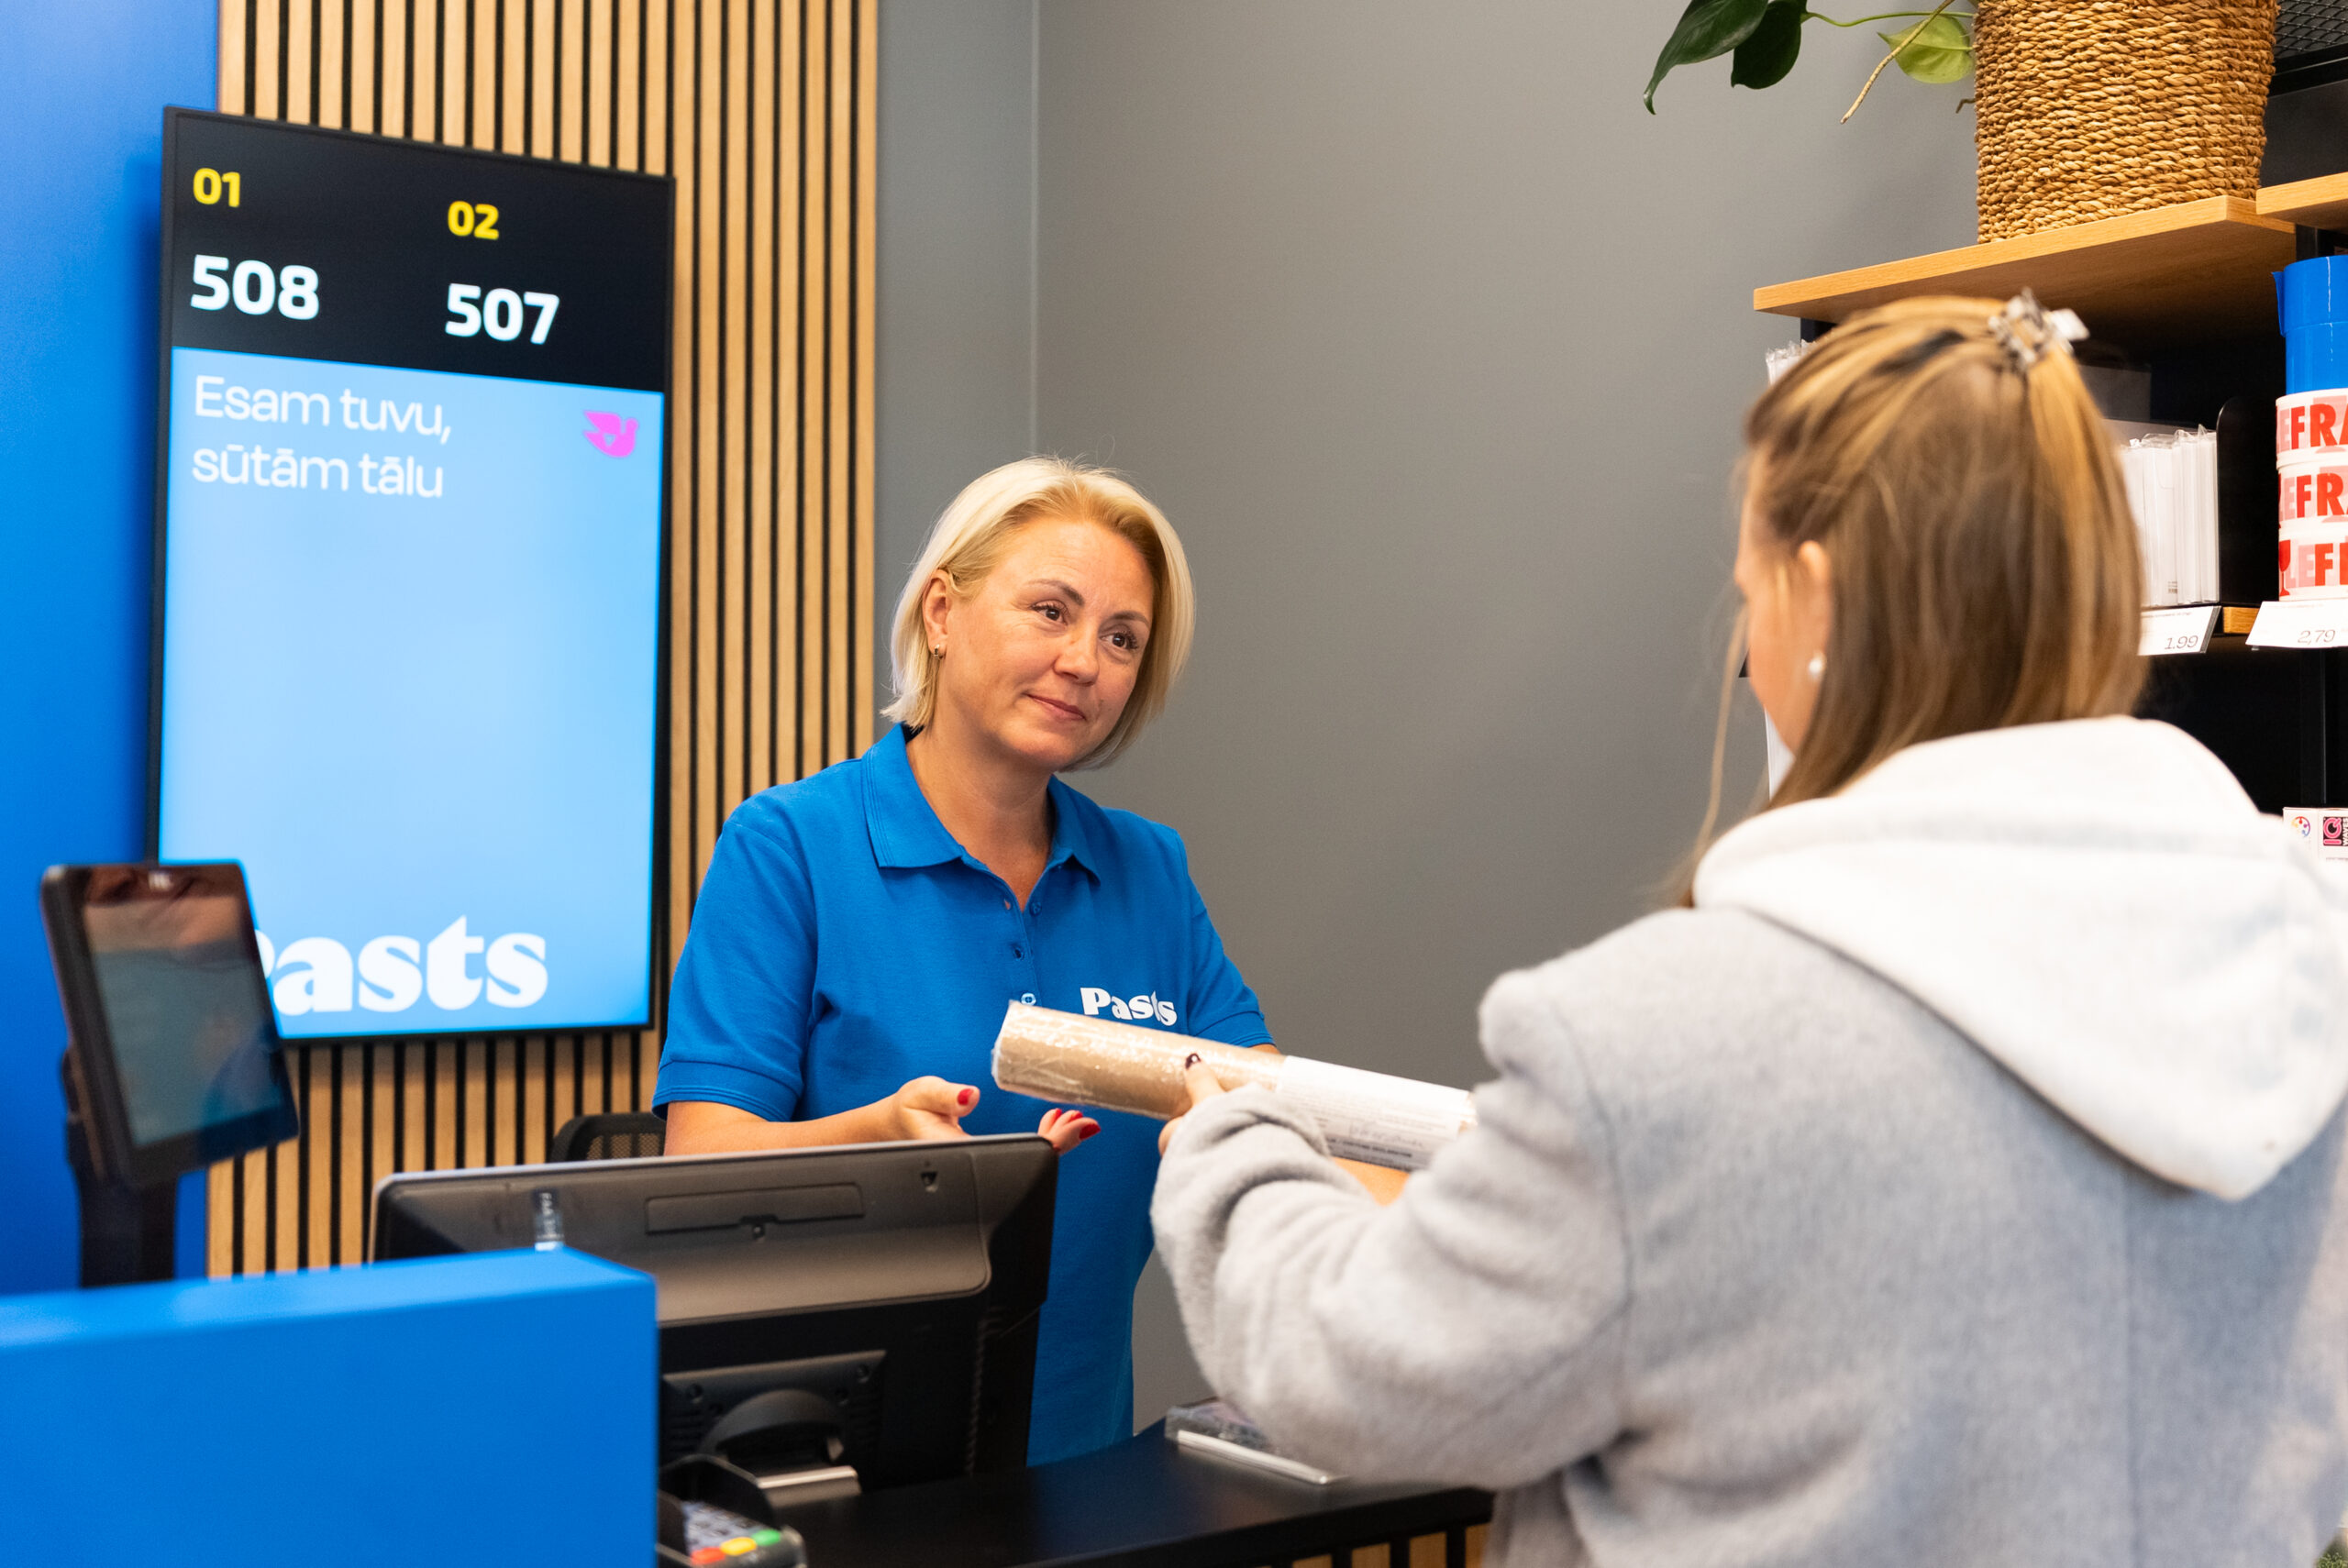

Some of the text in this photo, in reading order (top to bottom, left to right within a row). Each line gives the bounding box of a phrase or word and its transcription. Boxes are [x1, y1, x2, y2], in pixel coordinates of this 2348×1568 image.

[193, 167, 241, 208] 01
[448, 200, 500, 240] 02
[190, 253, 320, 321] 508
[445, 282, 560, 345] 507
[194, 375, 451, 445] Esam tuvu,
[192, 444, 444, 498] sūtām tālu
[2296, 472, 2348, 518] FR
[1080, 987, 1178, 1026] Pasts
